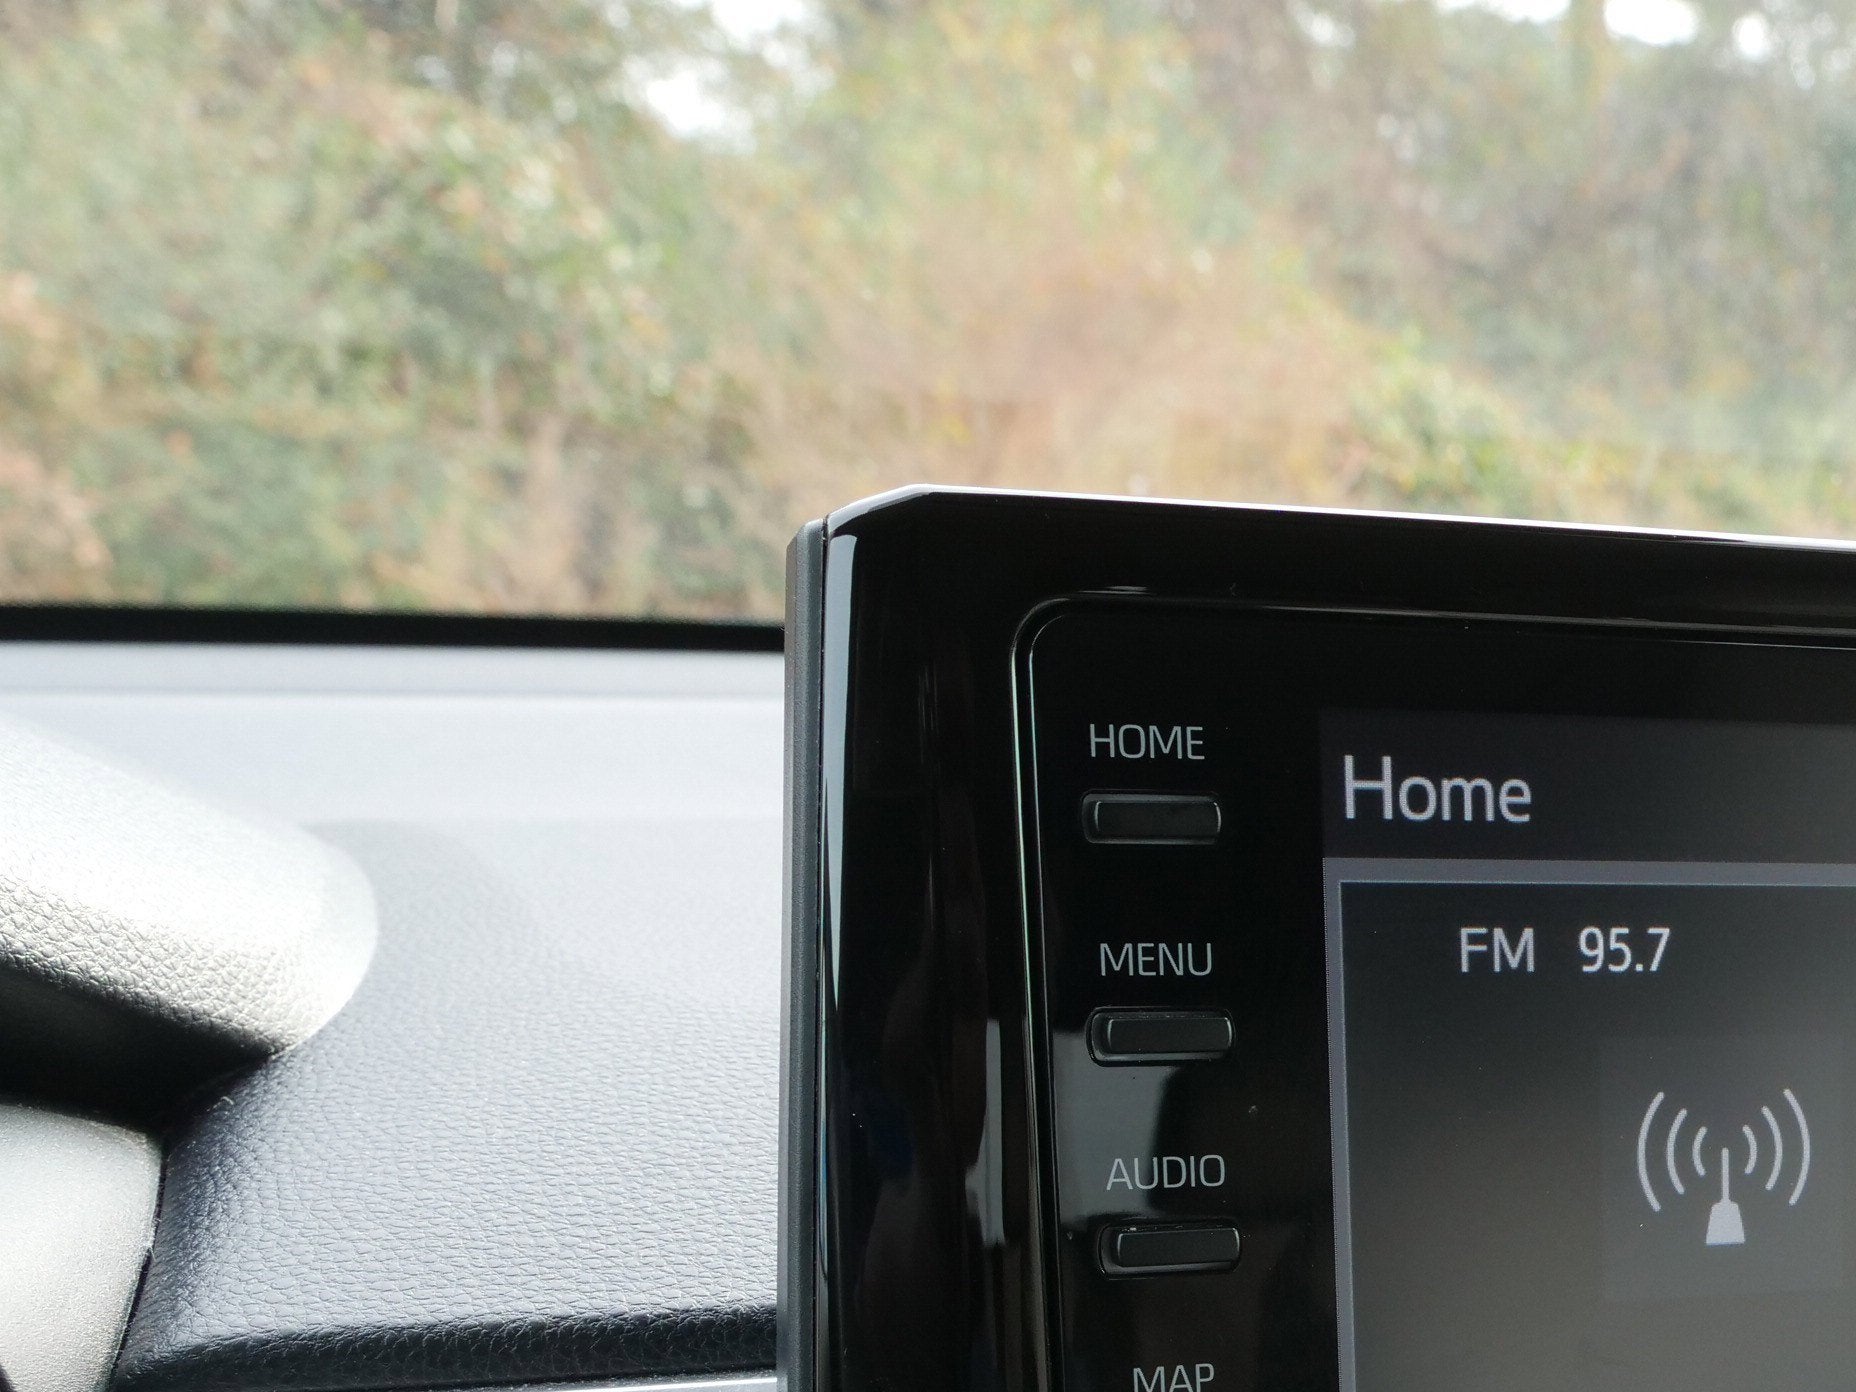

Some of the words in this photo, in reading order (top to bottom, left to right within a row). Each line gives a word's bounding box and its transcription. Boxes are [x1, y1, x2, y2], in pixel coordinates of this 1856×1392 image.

[1089, 722, 1206, 761] HOME
[1343, 754, 1532, 824] Home
[1099, 941, 1214, 977] MENU
[1458, 927, 1537, 974] FM
[1577, 926, 1672, 974] 95.7
[1105, 1153, 1227, 1192] AUDIO
